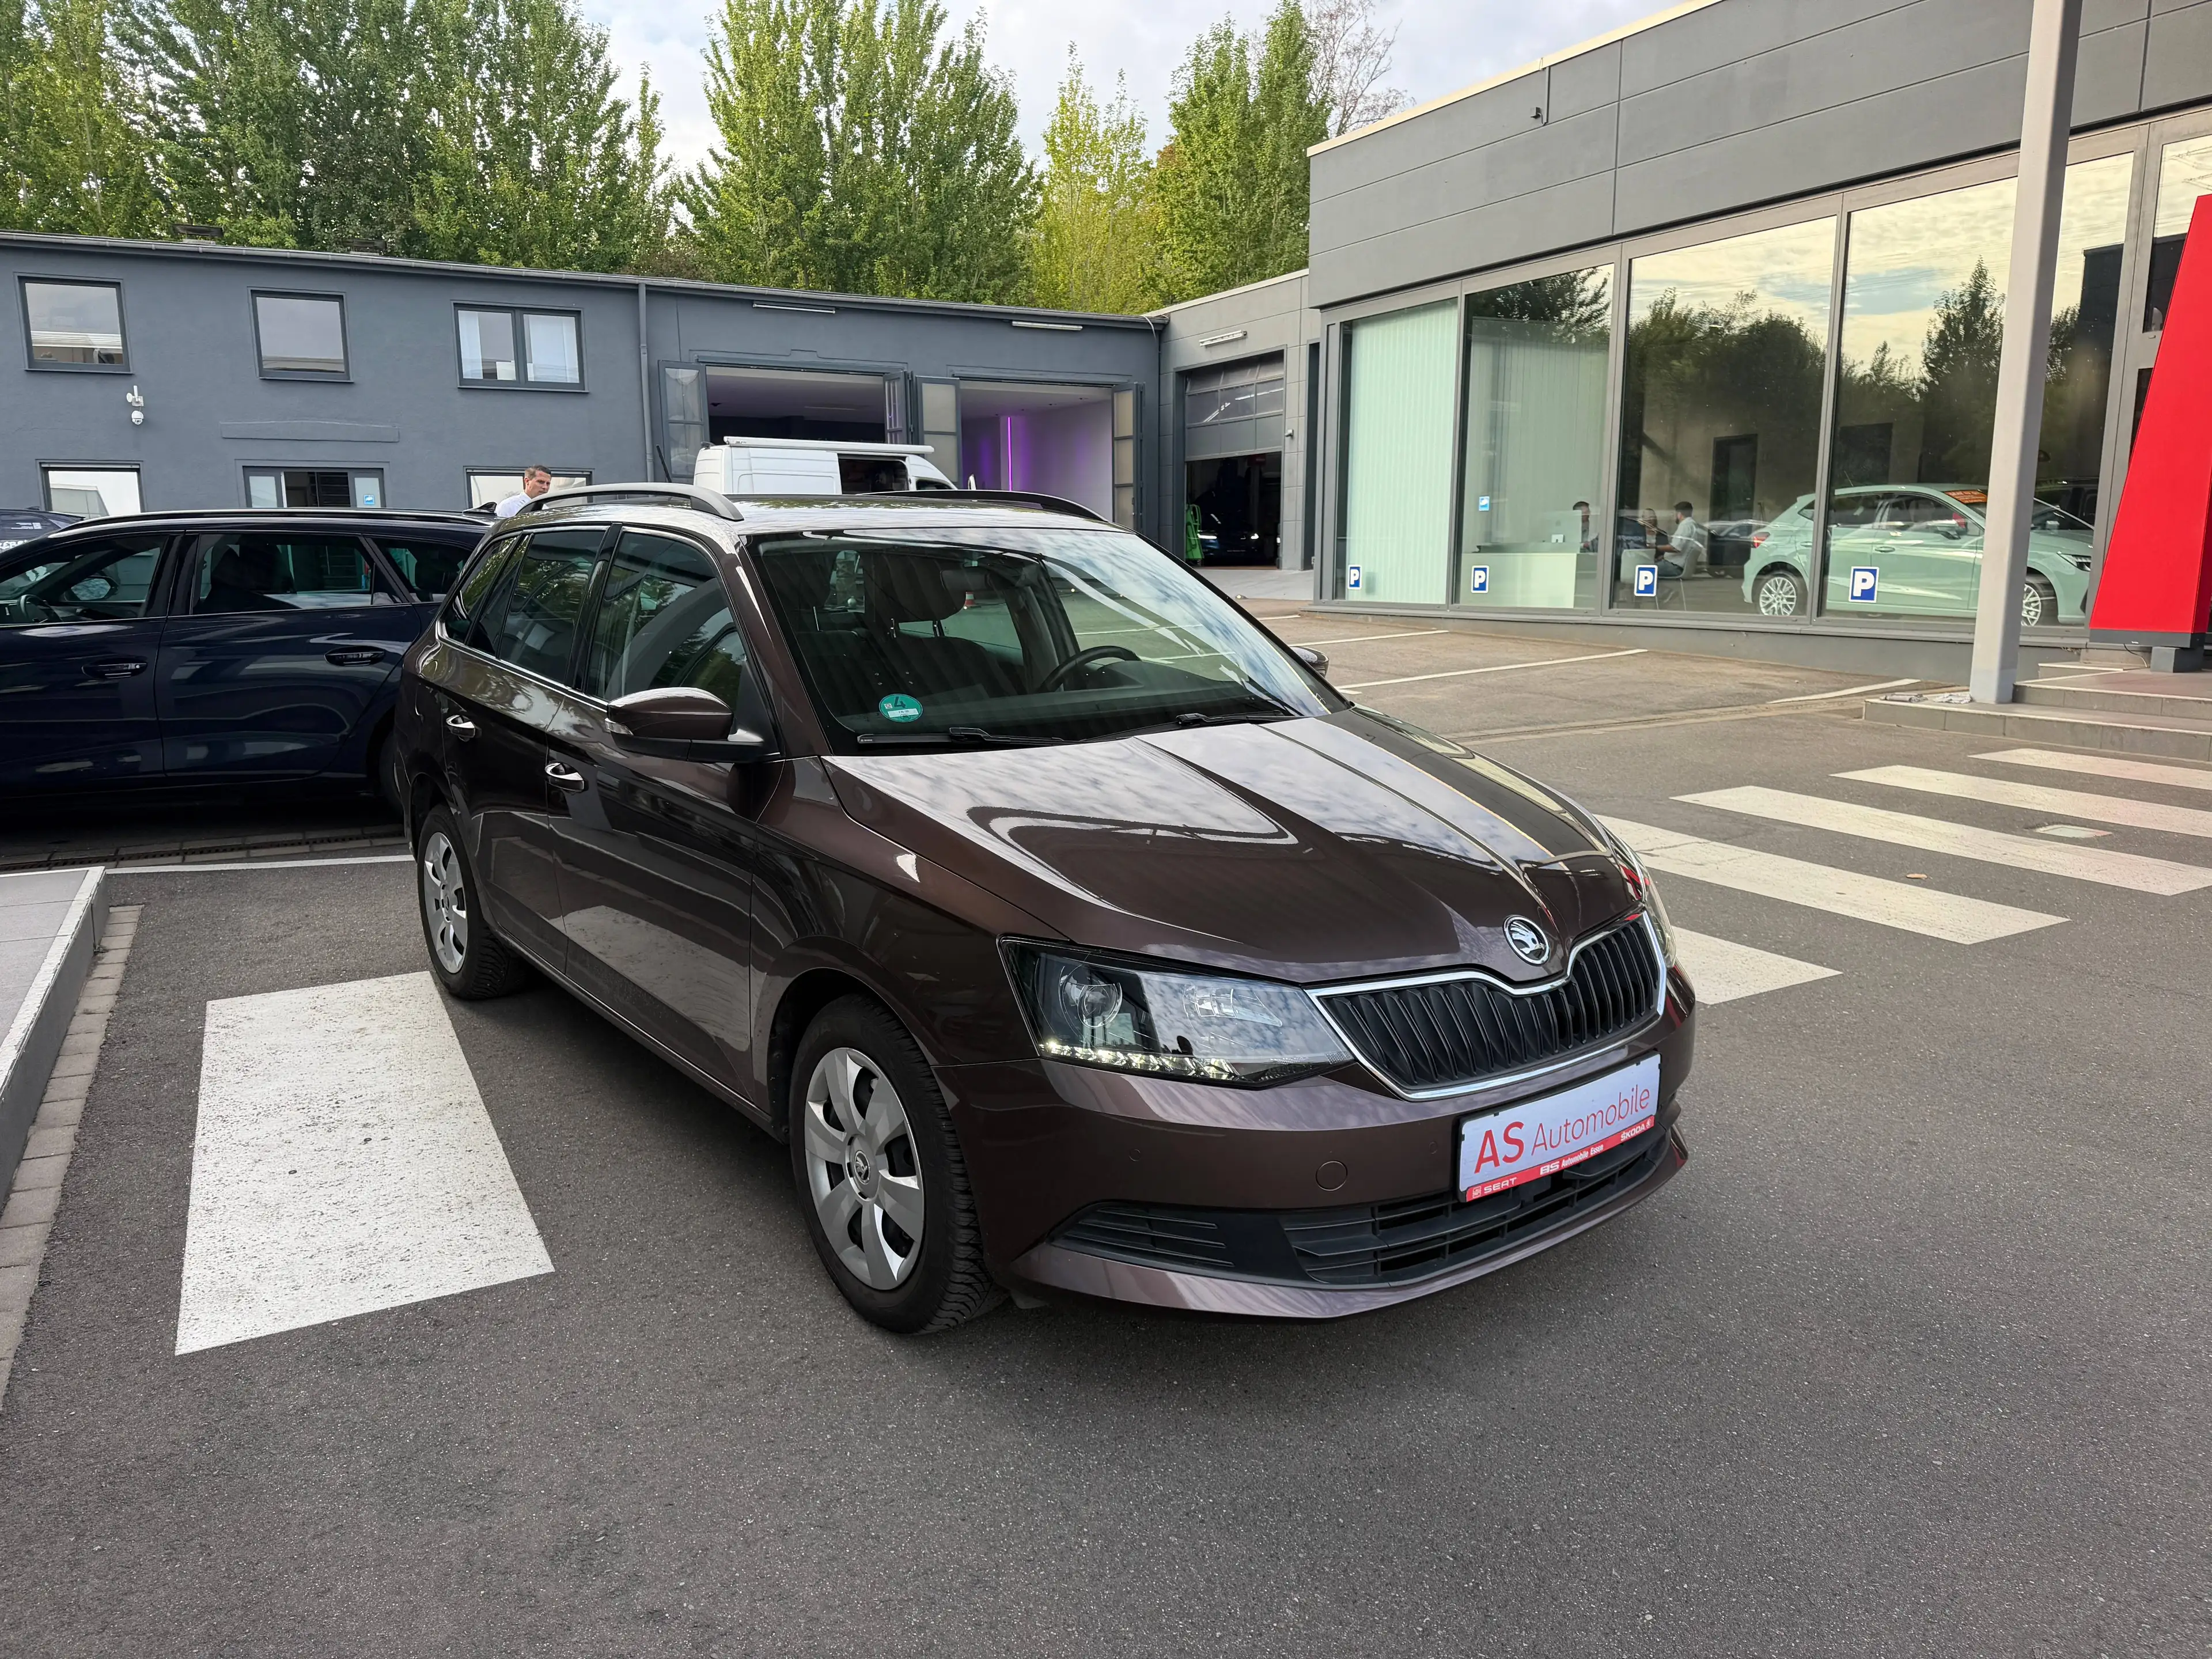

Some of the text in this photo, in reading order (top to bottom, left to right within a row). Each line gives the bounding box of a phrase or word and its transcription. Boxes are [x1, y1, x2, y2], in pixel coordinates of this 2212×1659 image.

[1350, 569, 1359, 585] P
[1474, 570, 1486, 588] P
[1638, 570, 1653, 590] P
[1853, 571, 1874, 597] P
[894, 696, 906, 708] 4
[1474, 1084, 1650, 1175] AS Automobile
[1561, 1150, 1589, 1168] Automobile
[1590, 1144, 1604, 1156] Essen
[1484, 1177, 1517, 1194] SEAT
